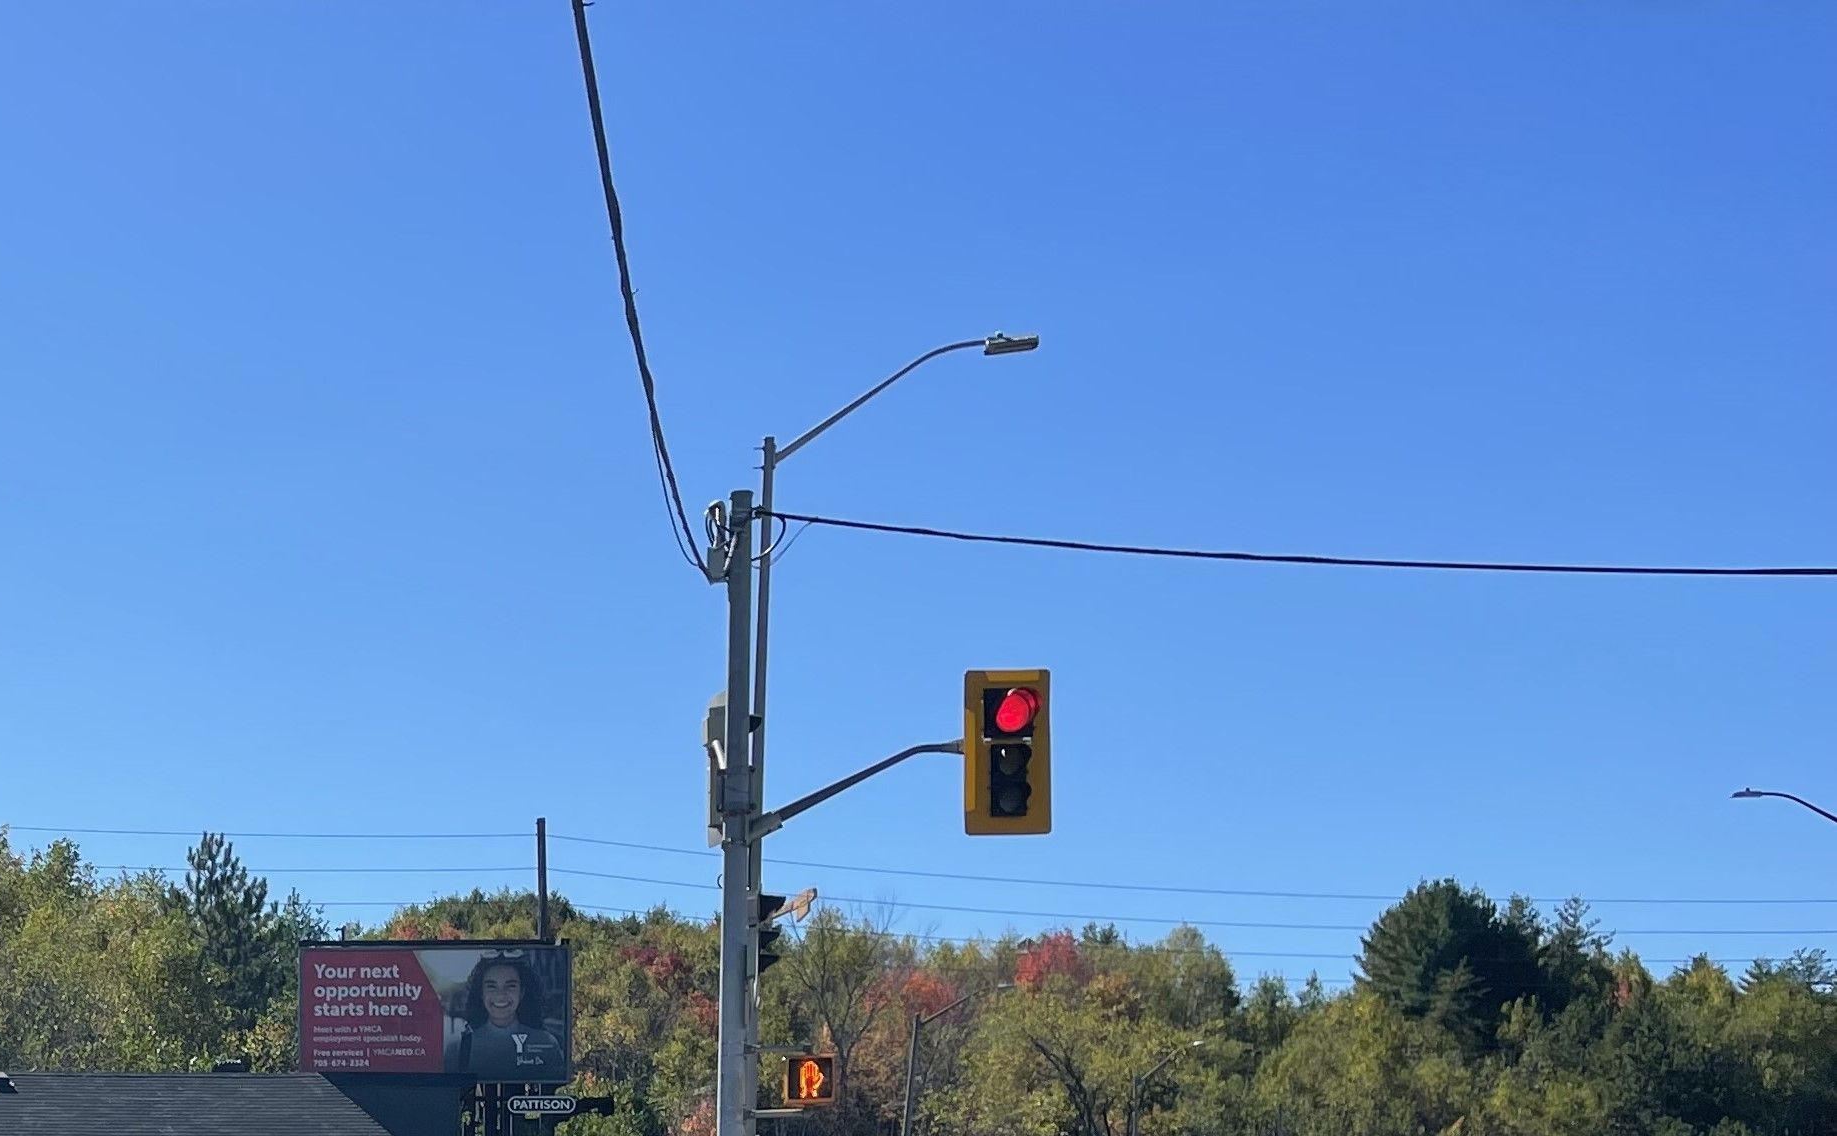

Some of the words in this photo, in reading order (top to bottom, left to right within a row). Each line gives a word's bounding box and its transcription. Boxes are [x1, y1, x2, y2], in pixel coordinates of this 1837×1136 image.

[314, 964, 356, 979] Your
[360, 965, 400, 979] next
[313, 982, 422, 1001] opportunity
[314, 1003, 364, 1017] starts
[368, 1001, 413, 1017] here.
[359, 1025, 382, 1033] YMCA
[513, 1100, 570, 1110] PATTISON
